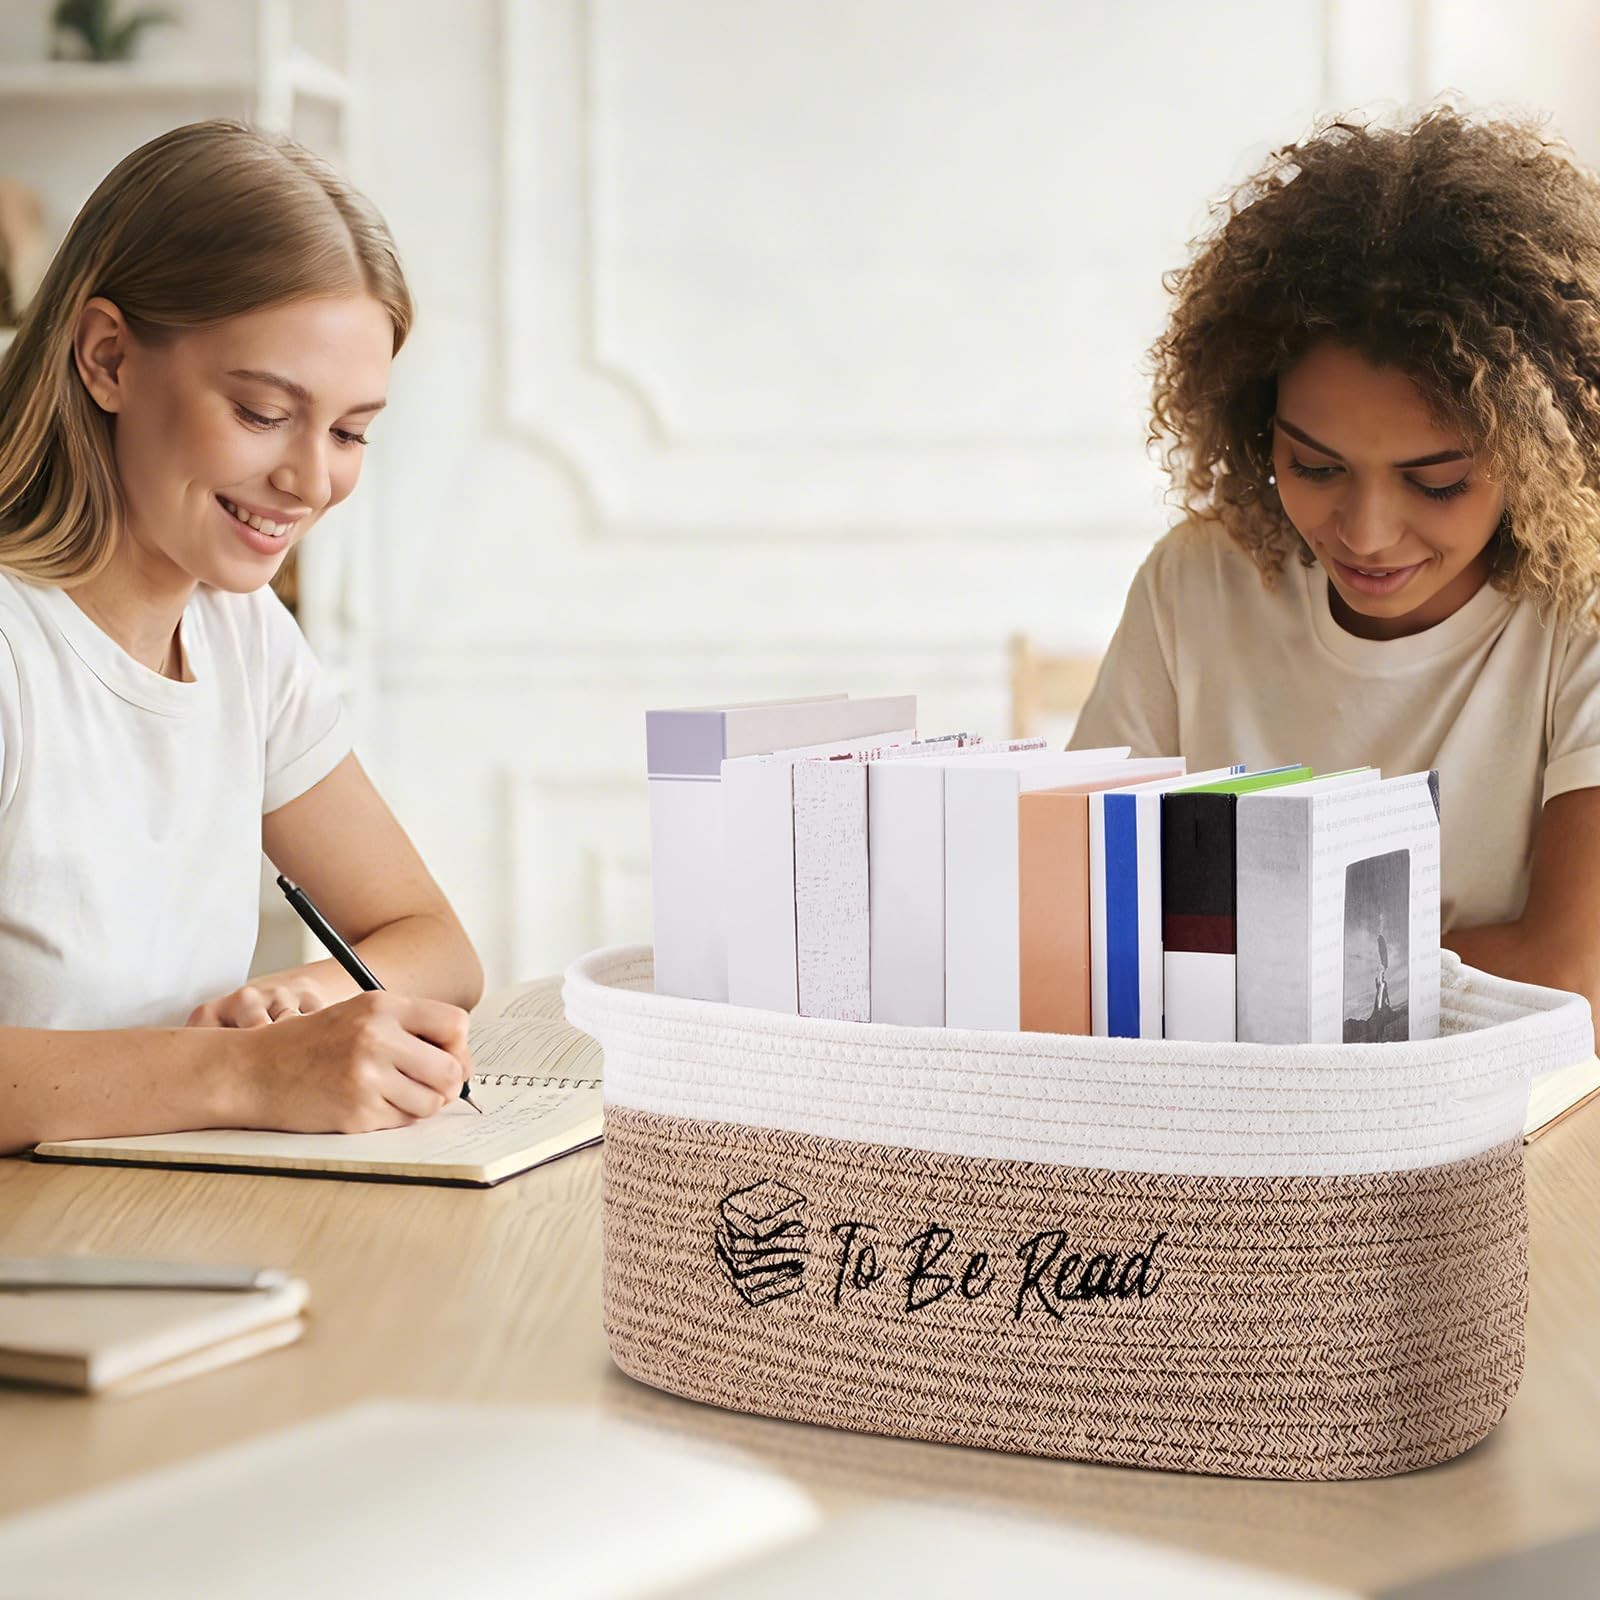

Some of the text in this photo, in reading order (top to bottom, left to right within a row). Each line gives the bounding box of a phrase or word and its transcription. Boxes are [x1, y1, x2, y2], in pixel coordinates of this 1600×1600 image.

[830, 1221, 1168, 1321] To Be Read
